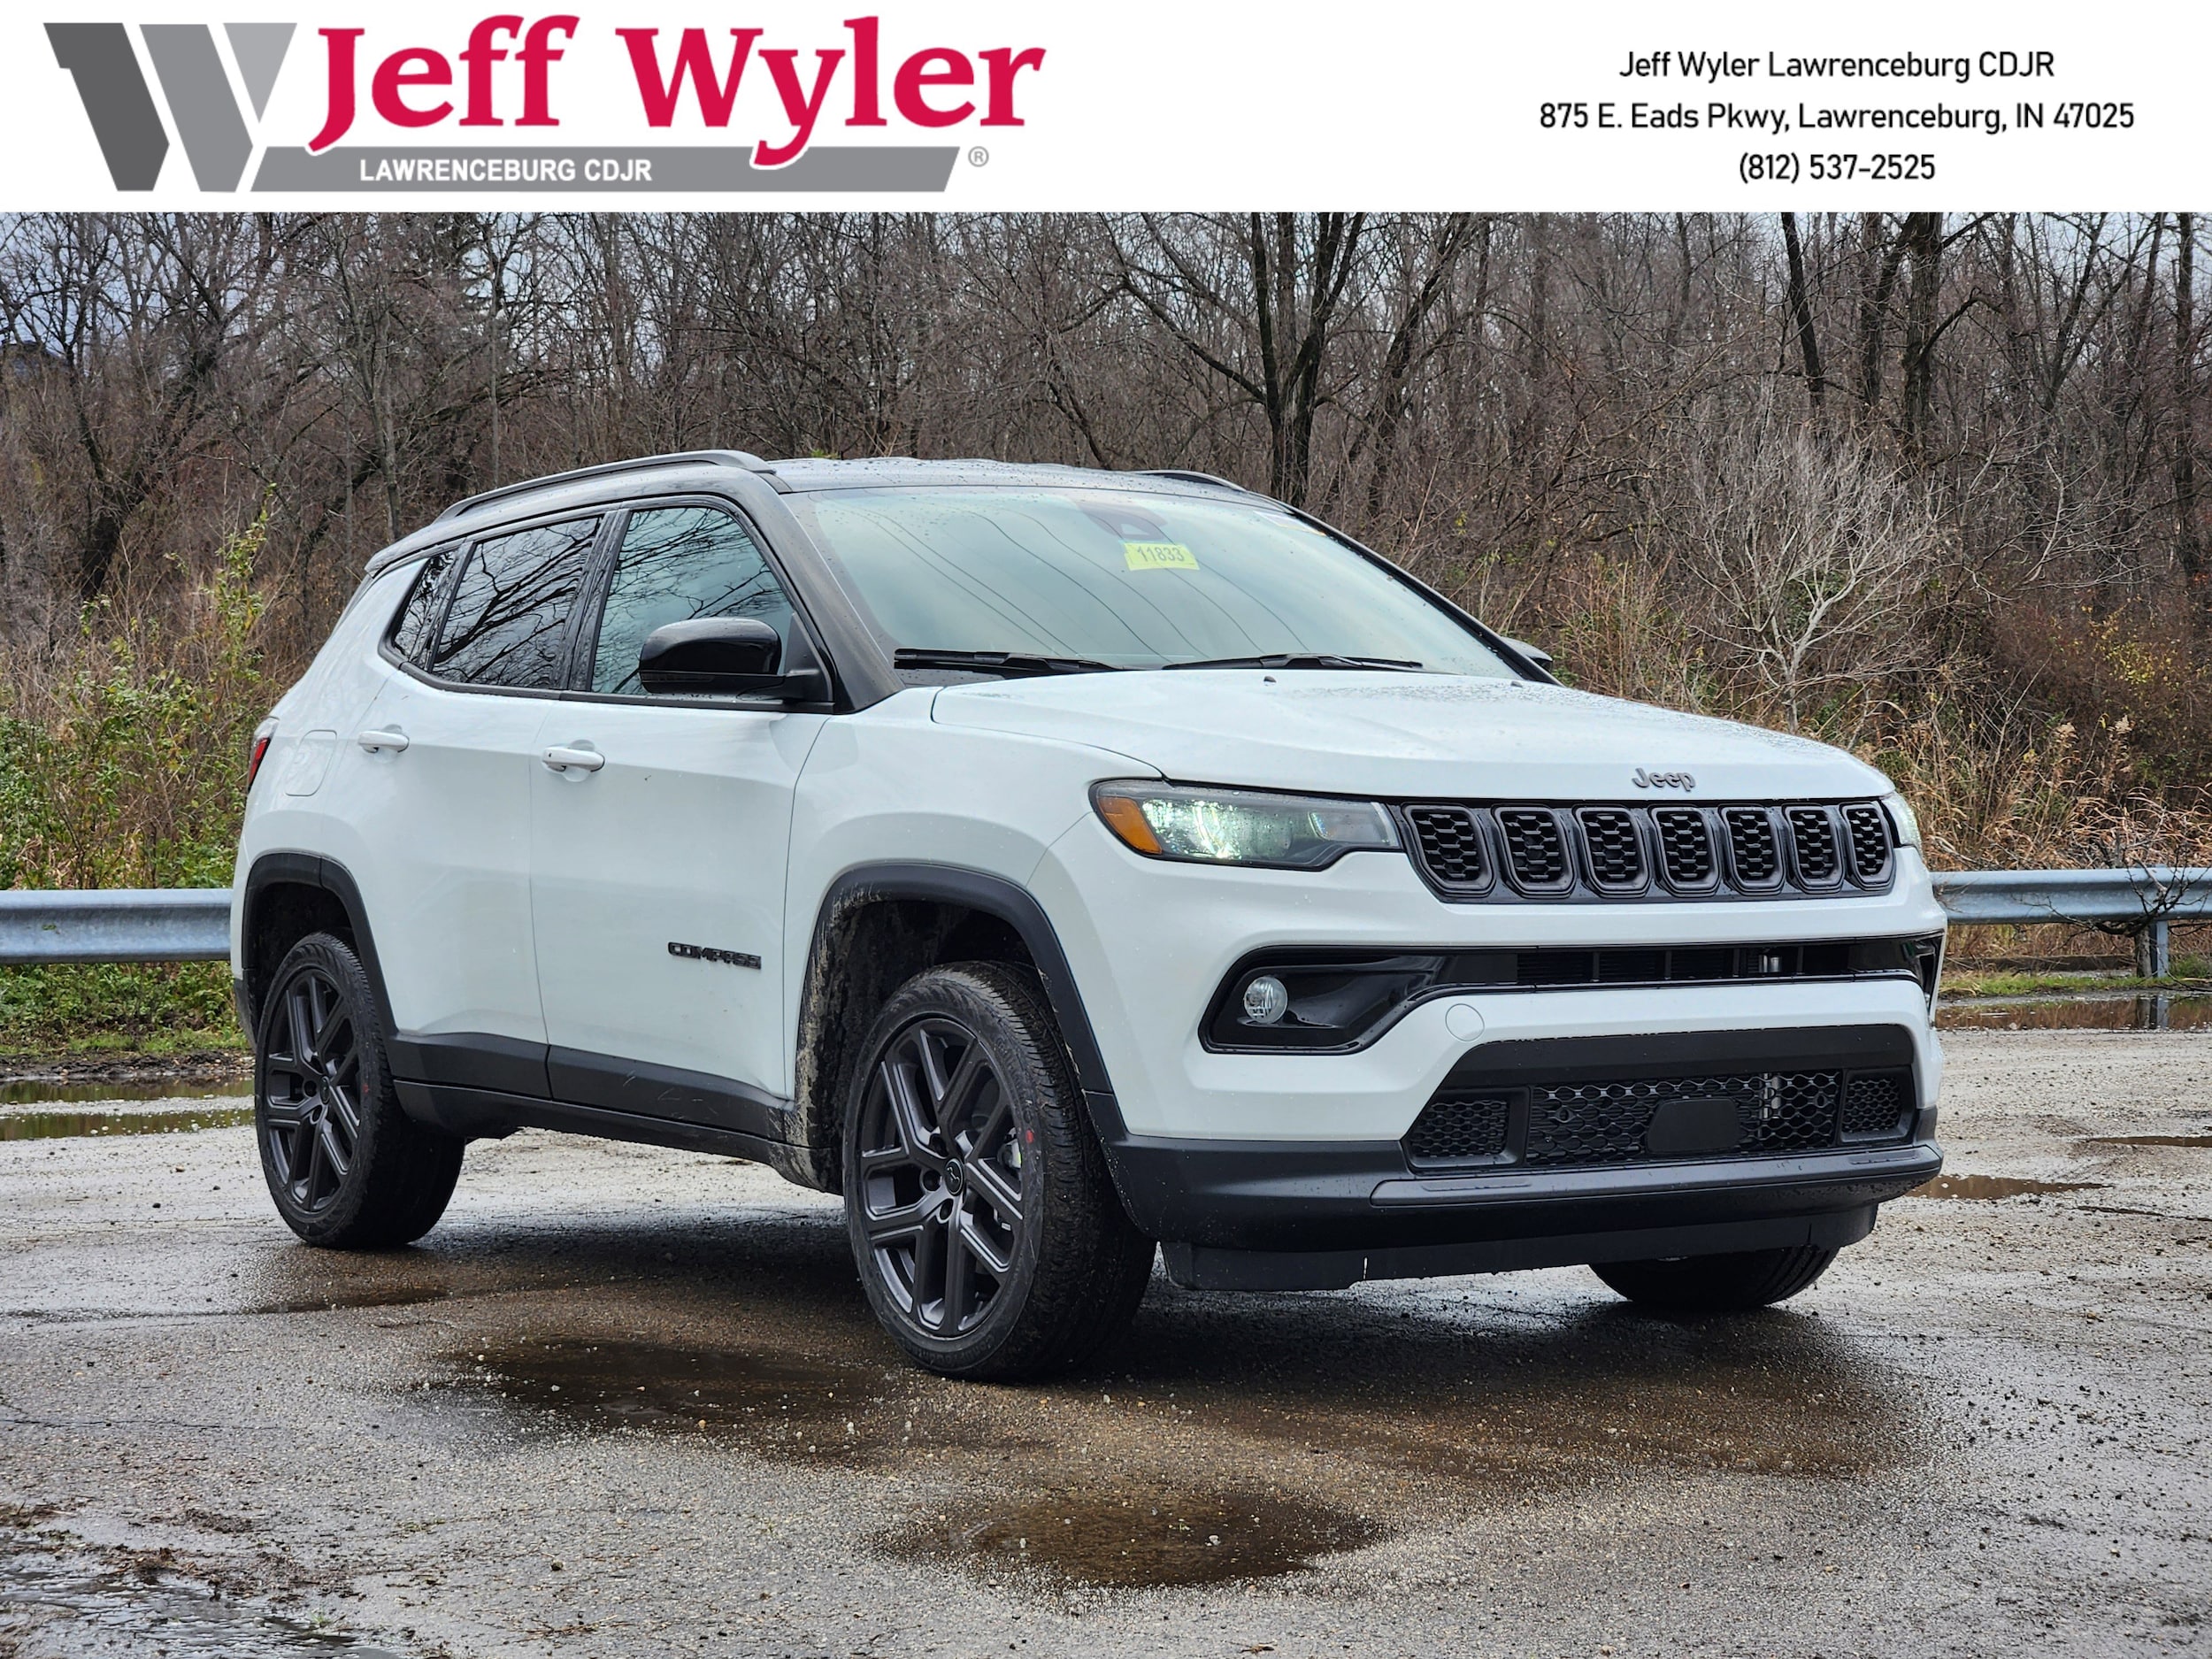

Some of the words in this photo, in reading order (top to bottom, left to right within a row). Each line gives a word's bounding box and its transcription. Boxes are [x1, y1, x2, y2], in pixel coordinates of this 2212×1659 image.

[1137, 546, 1185, 562] 11833
[1632, 767, 1696, 792] Jeep
[667, 941, 762, 970] COMPASS
